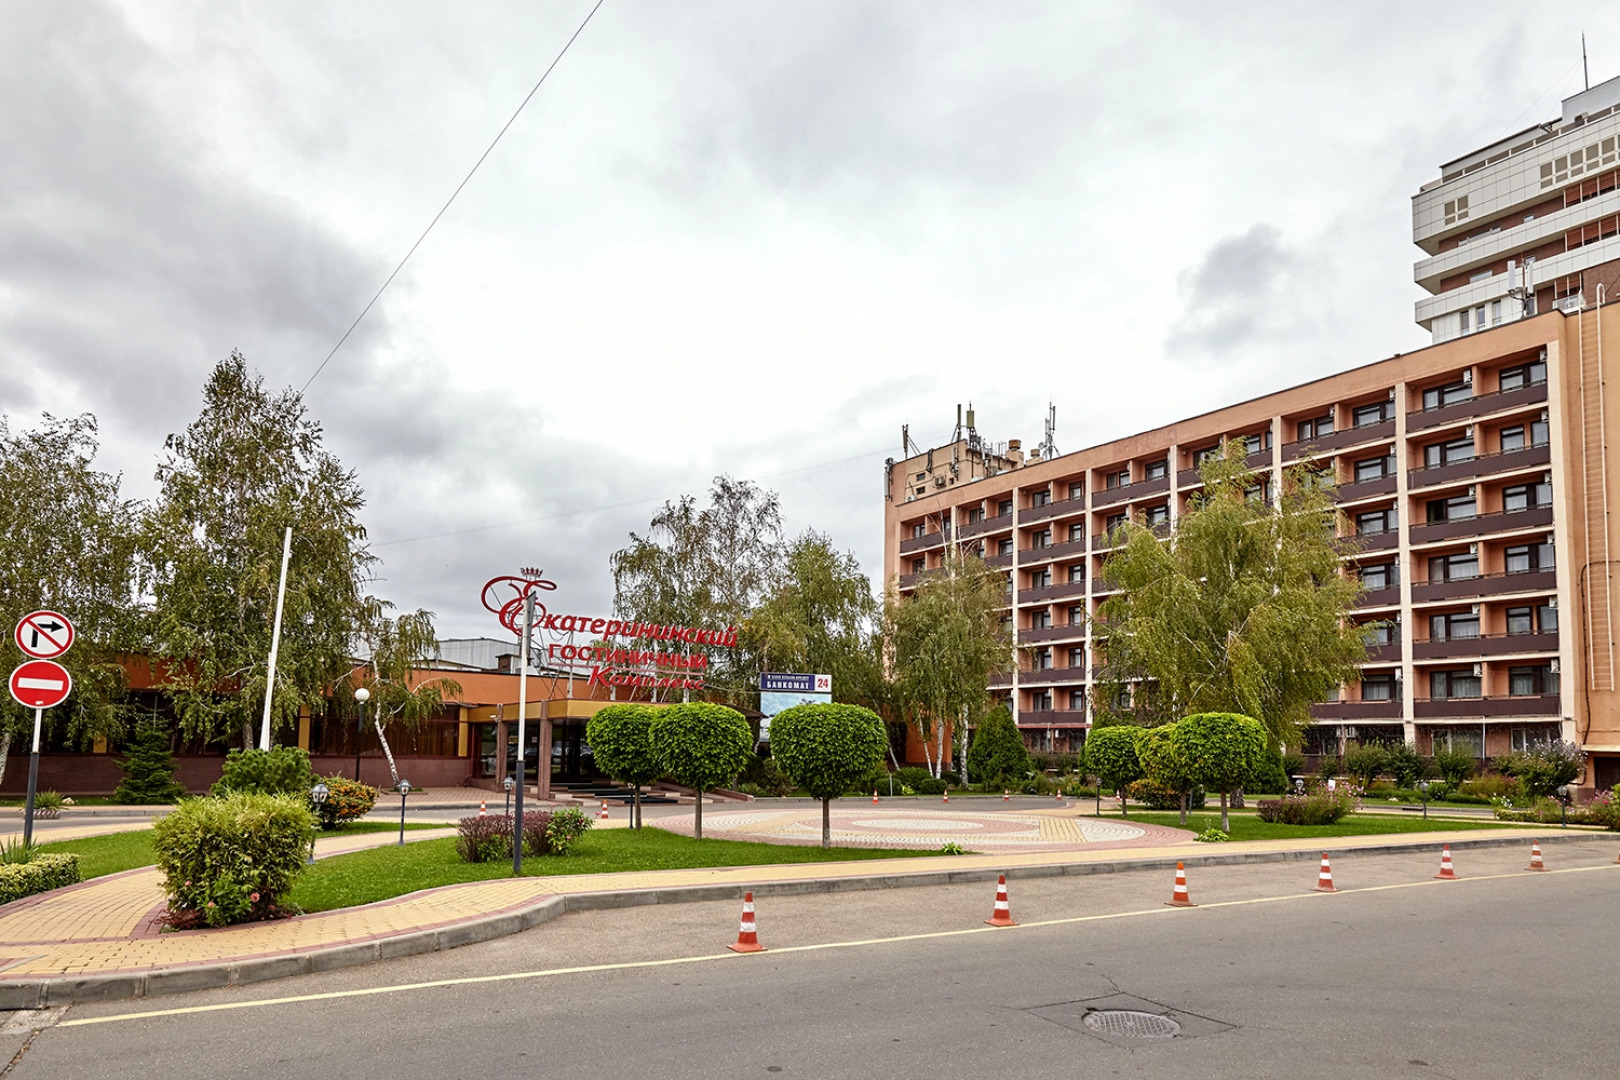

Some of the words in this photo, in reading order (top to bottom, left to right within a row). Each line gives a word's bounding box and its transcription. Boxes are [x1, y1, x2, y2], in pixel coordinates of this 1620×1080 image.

[587, 665, 704, 690] Комплекс
[767, 681, 809, 689] БАНКОМАТ
[817, 678, 829, 688] 24
